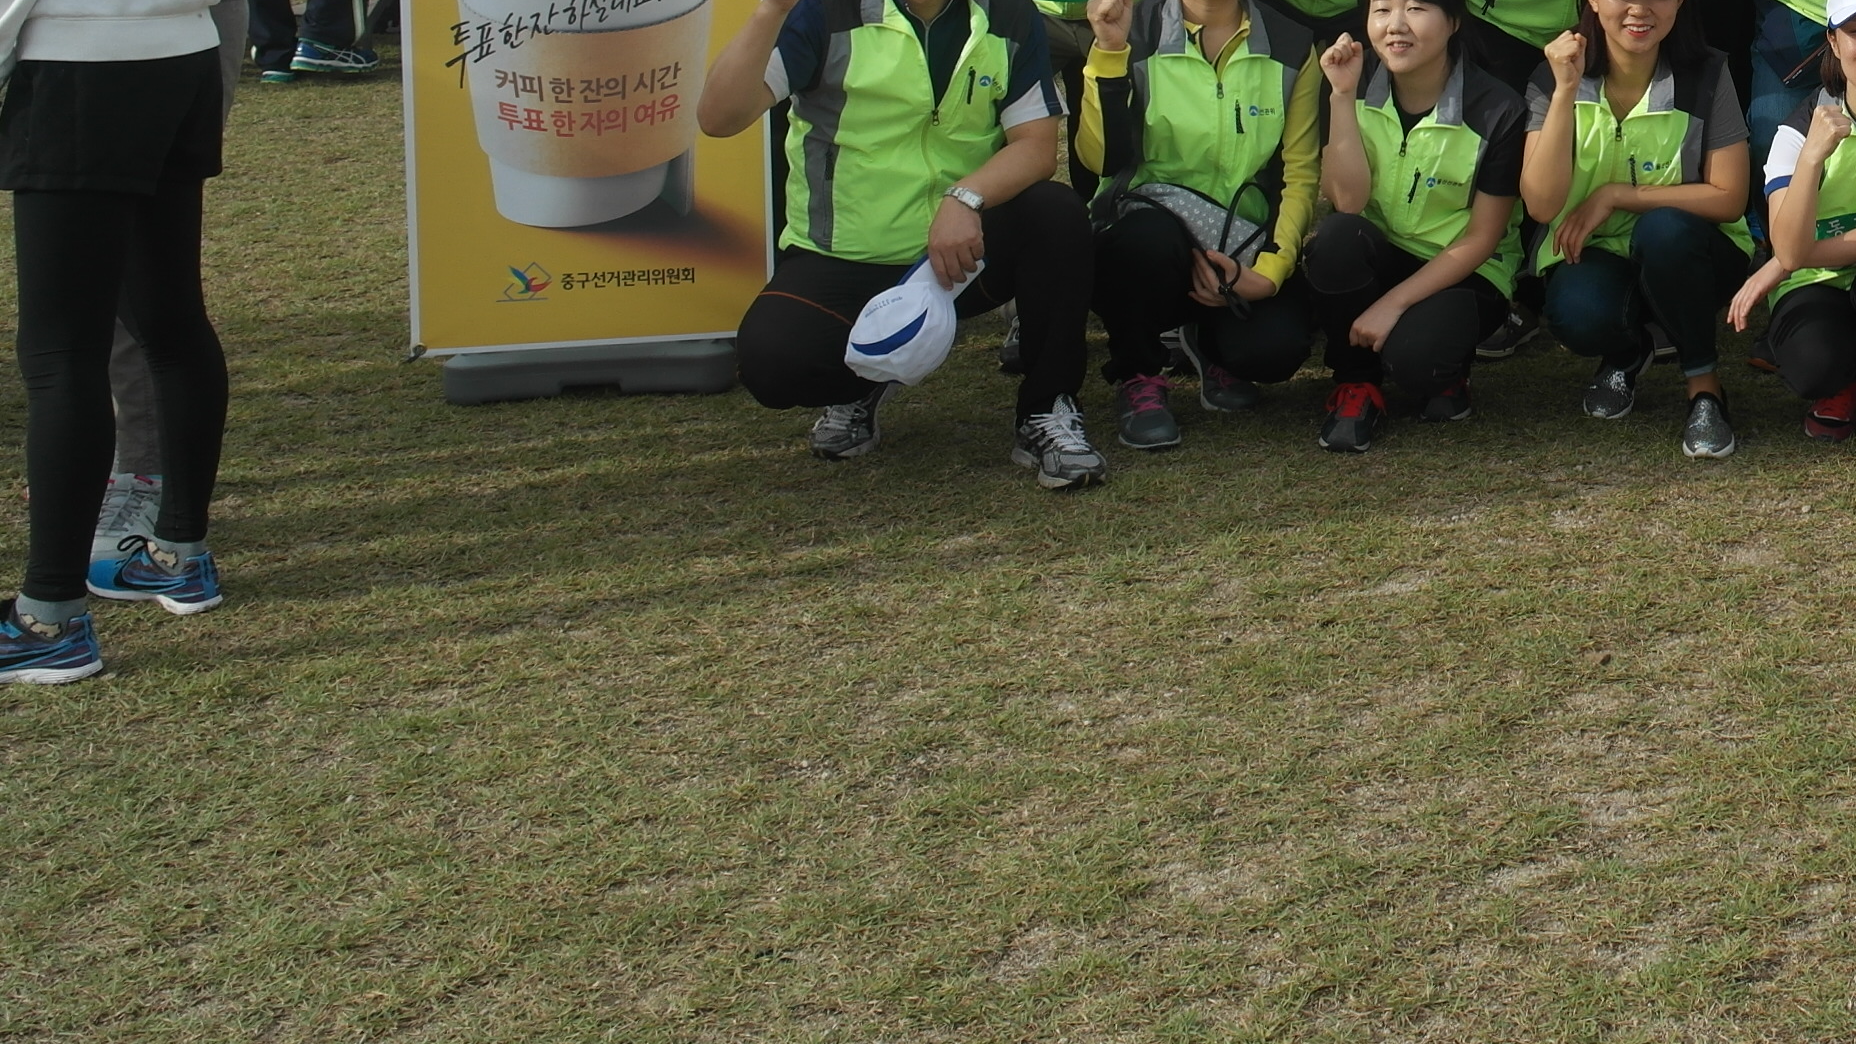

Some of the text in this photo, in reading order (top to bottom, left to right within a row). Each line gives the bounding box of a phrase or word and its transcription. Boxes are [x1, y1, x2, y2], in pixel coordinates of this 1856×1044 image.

[445, 20, 496, 88] 투표
[495, 61, 682, 104] 커피 한 잔의 시간
[498, 93, 681, 138] 투표 한 자의 여유
[561, 267, 696, 291] 중구선거관리위원회
